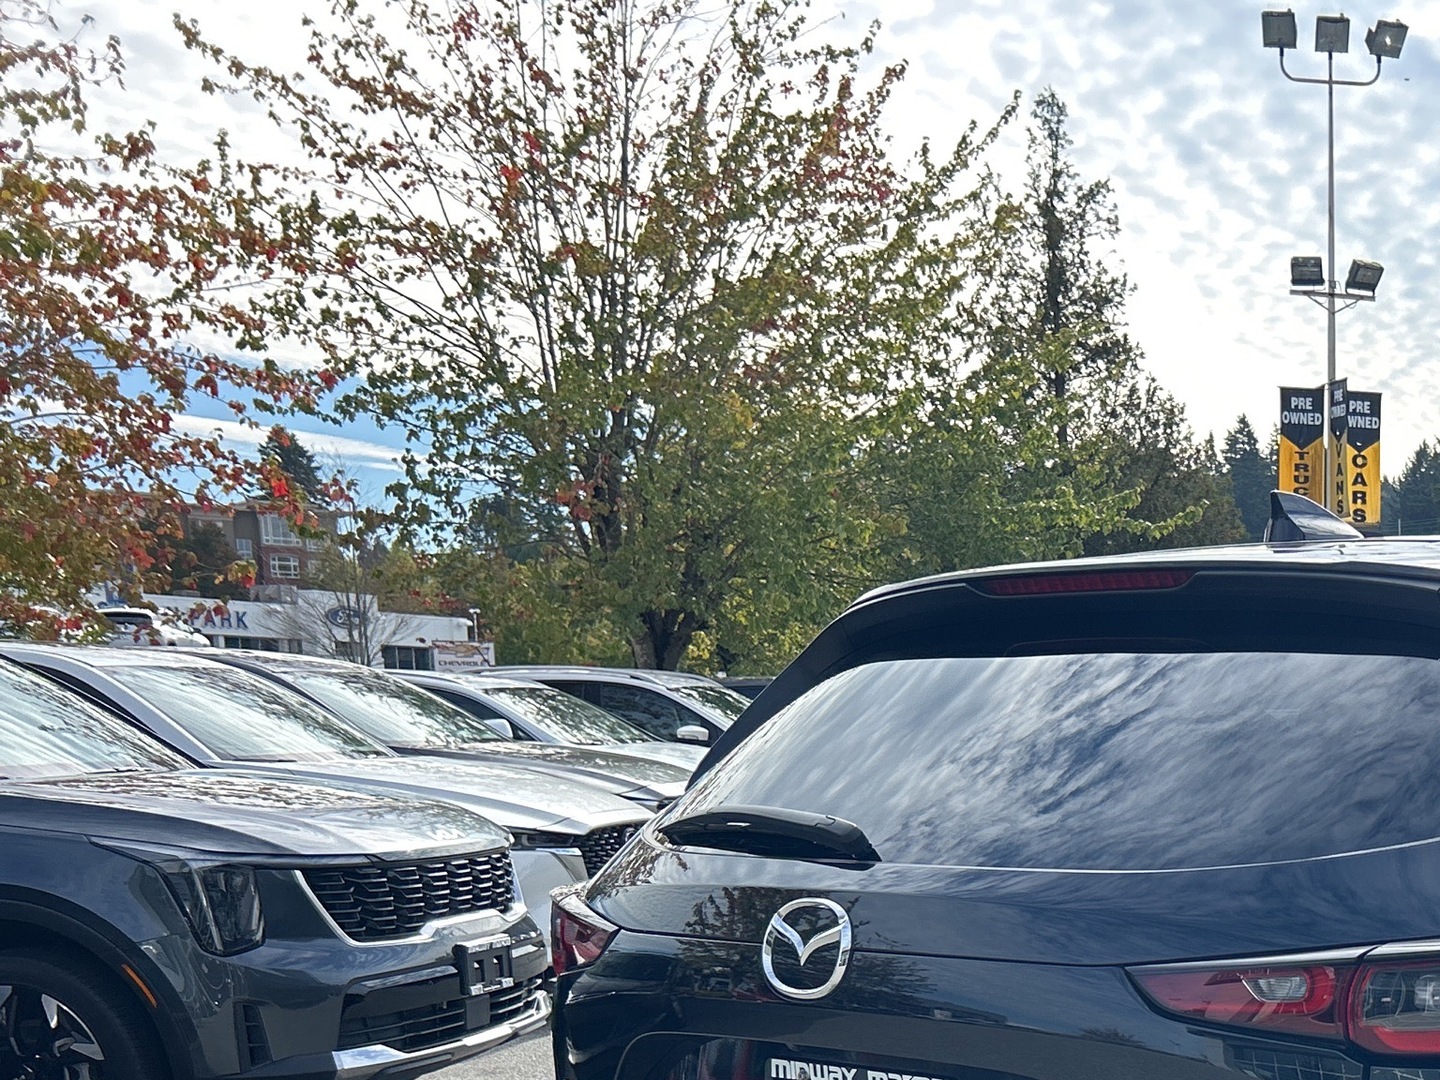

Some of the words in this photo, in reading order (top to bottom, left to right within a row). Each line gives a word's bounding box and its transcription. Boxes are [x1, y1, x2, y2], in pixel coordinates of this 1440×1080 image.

[1290, 396, 1313, 410] PRE
[1349, 400, 1371, 414] PRE
[1281, 411, 1323, 425] OWNED
[1347, 415, 1380, 429] WNED
[1293, 451, 1310, 496] TRUC
[1335, 442, 1344, 514] VANS
[1351, 454, 1368, 523] CARS
